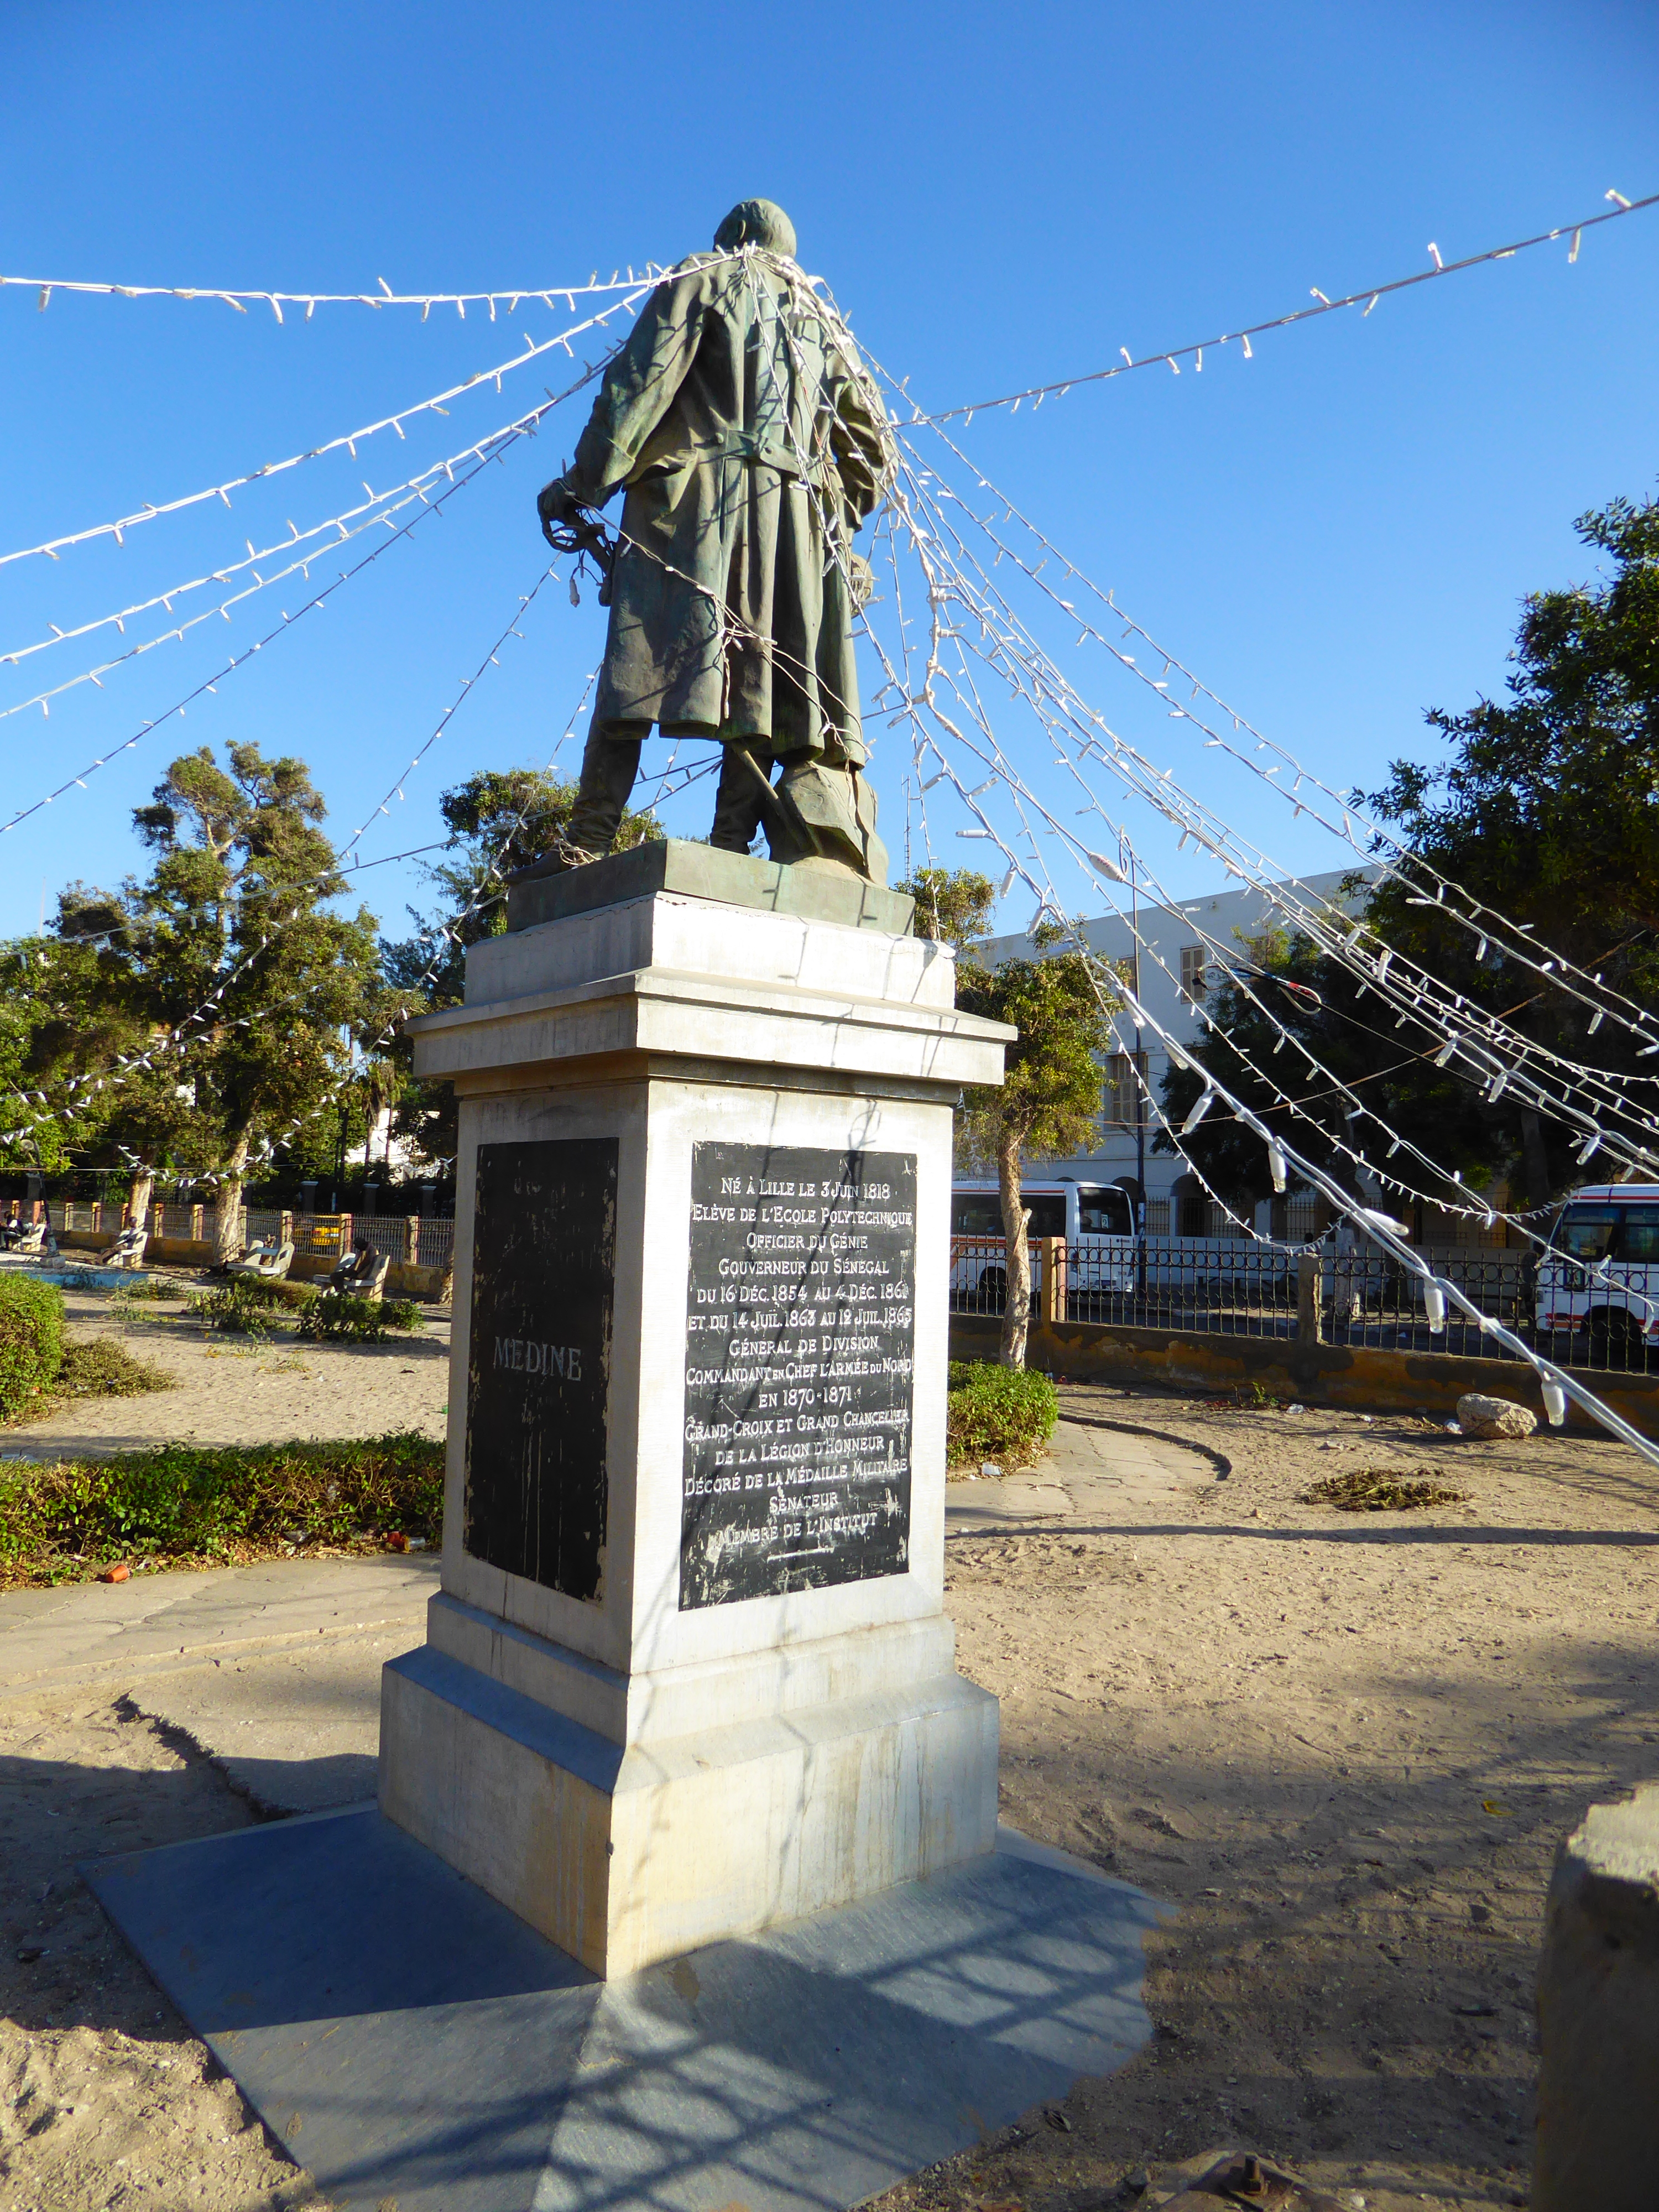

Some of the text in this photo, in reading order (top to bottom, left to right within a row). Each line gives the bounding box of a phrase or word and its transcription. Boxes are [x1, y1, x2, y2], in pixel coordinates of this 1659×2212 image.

[721, 1176, 890, 1198] NÉ À LILLE LE 3 JUIN 1818
[740, 1208, 757, 1222] DE
[762, 1206, 816, 1223] L'ECOLE
[821, 1207, 912, 1226] POLYTECHNIQUE
[747, 1232, 868, 1249] OFFICIER DU GÉNIE
[719, 1258, 807, 1275] GOUVERNEUR
[810, 1261, 829, 1274] DU
[697, 1288, 716, 1303] DU
[721, 1284, 735, 1303] 16
[739, 1285, 769, 1302] DÉC.
[772, 1285, 807, 1301] 1854
[814, 1287, 831, 1300] AU
[836, 1285, 846, 1300] 4
[849, 1284, 877, 1300] DÉC.
[688, 1306, 912, 1330] ET DU 14 JUIL. 1863 AU 12 JUIL. 1865
[798, 1339, 817, 1352] DE
[822, 1335, 879, 1351] DIVISION
[493, 1337, 582, 1381] MEDINE
[686, 1357, 912, 1384] COMMANDANT EN CHEF L'ARMÉE DU NORD
[759, 1393, 778, 1408] EN
[685, 1409, 910, 1441] GRAND-CROIX ET GRAND CHANCELIER
[715, 1436, 884, 1465] DE LA LÉGION D'HONNEUR
[685, 1472, 740, 1496] DÉCORÉ
[745, 1474, 763, 1489] DE
[768, 1472, 783, 1486] LA
[785, 1465, 847, 1484] MÉDAILLE
[719, 1512, 878, 1546] MEMBRE DE L'INSTITUT
